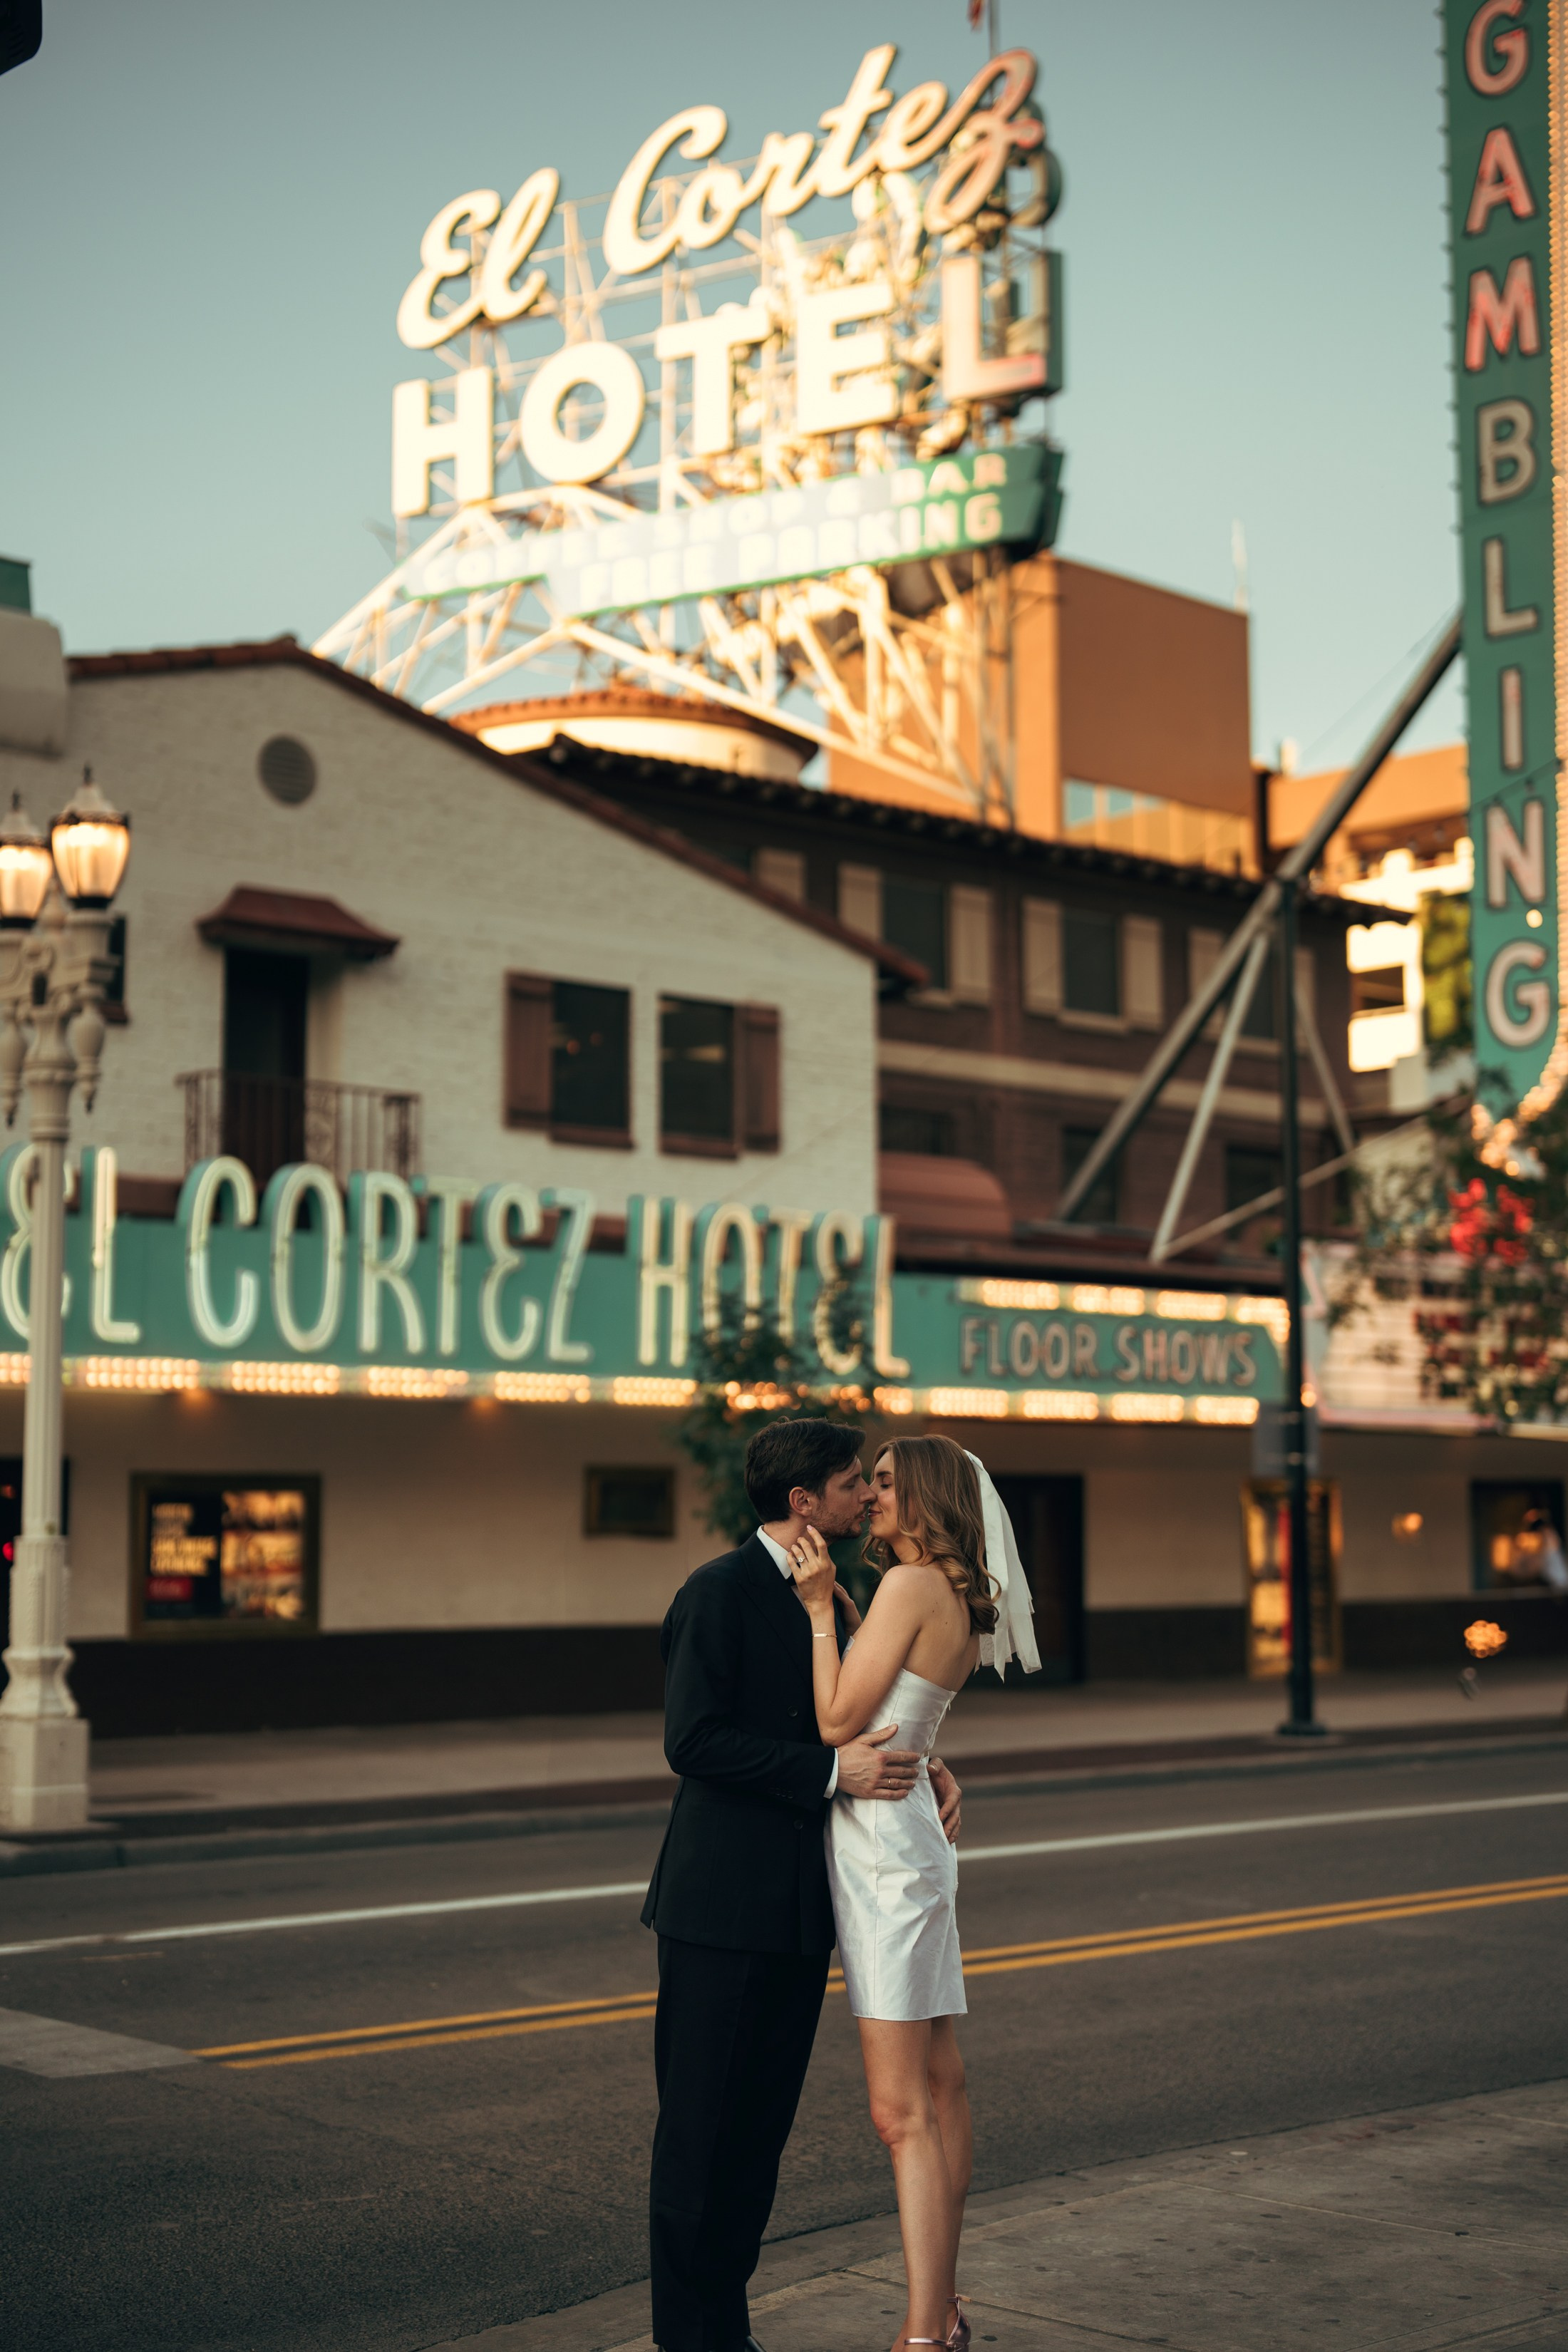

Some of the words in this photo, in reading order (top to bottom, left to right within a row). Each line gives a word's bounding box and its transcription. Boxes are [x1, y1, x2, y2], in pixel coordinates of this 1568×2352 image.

[396, 166, 560, 349] El
[602, 42, 1045, 275] Cortez
[391, 254, 1048, 518] HOTEL
[890, 453, 1006, 505] BAR
[738, 492, 1002, 582] PARKING
[1464, 0, 1551, 1049] GAMBLING
[187, 1155, 594, 1363] CORTEZ
[639, 1197, 910, 1378] HOTEL
[961, 1316, 1100, 1379] FLOOR
[1115, 1325, 1257, 1387] SHOWS
